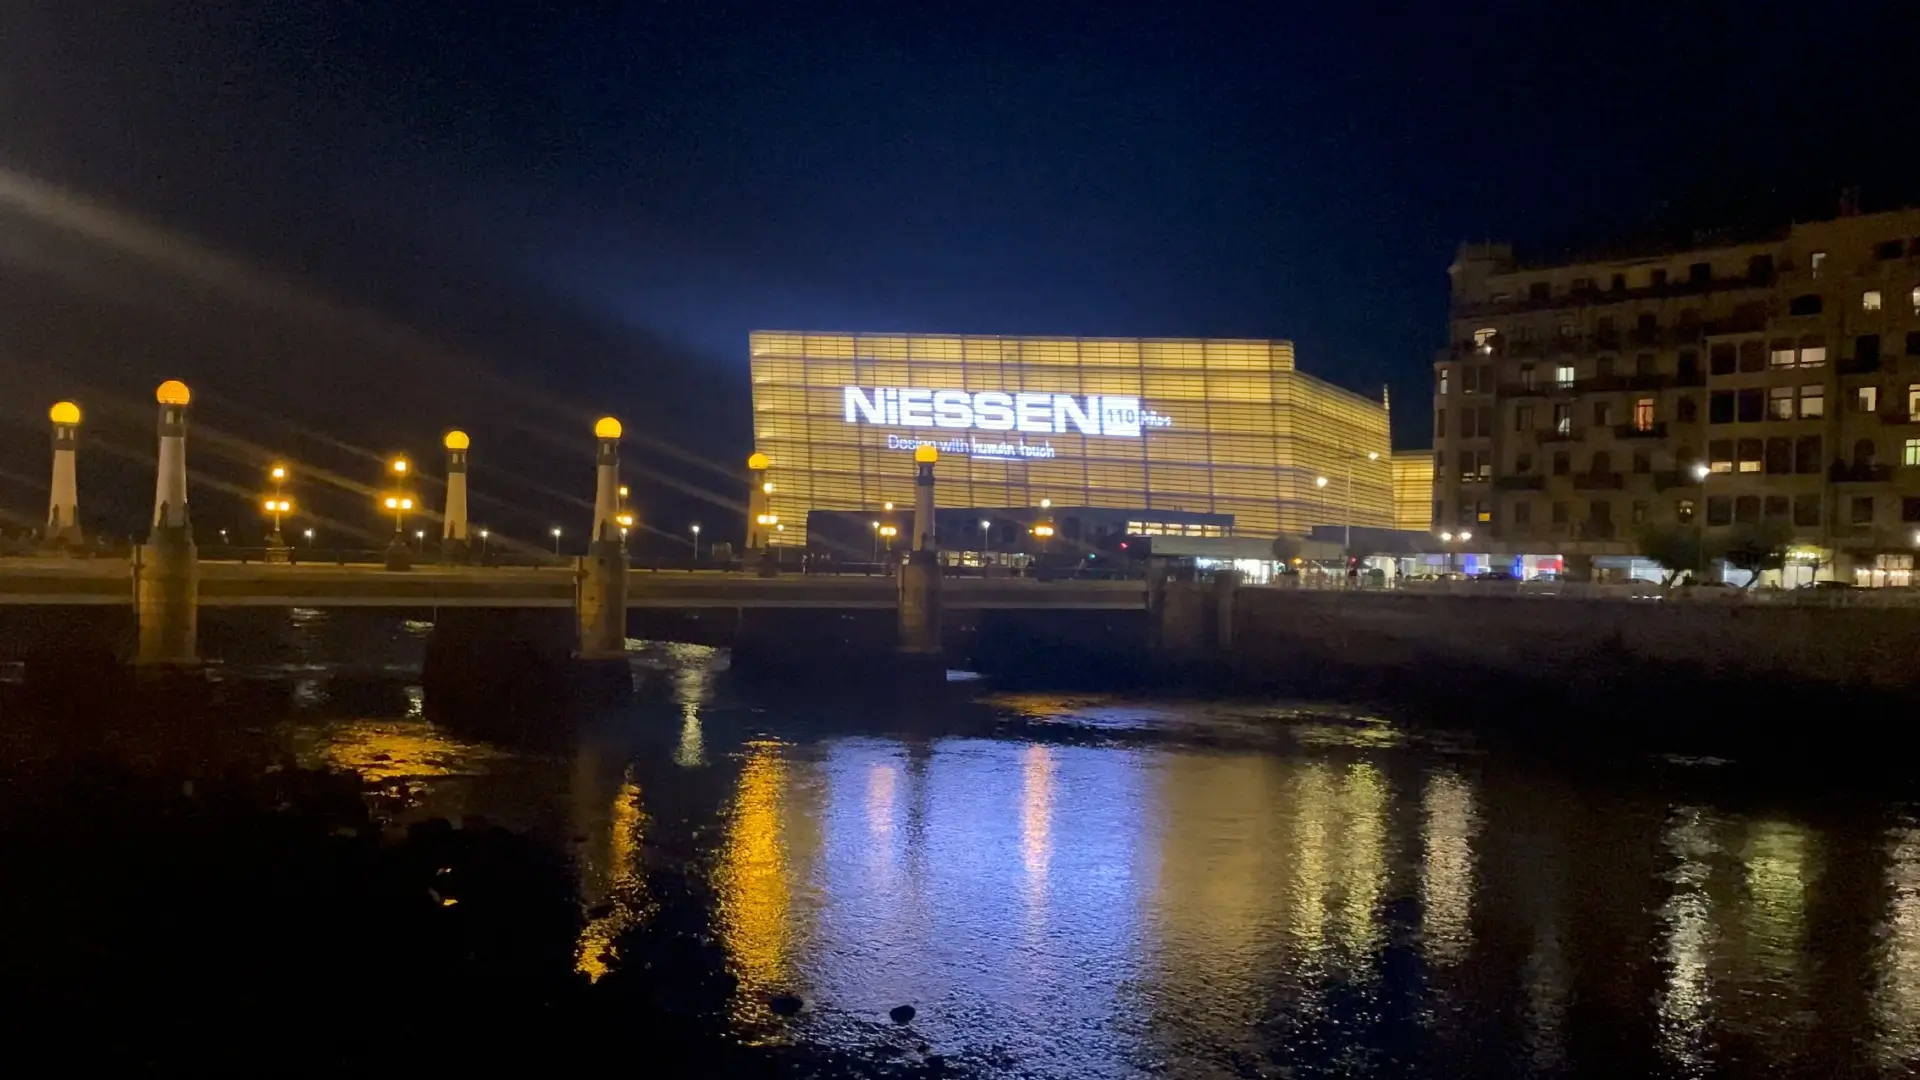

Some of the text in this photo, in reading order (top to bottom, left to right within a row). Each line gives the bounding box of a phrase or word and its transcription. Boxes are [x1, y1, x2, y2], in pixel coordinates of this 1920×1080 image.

[1107, 408, 1135, 424] 110
[940, 437, 969, 453] with
[971, 436, 1016, 456] human
[1019, 438, 1056, 458] touch
